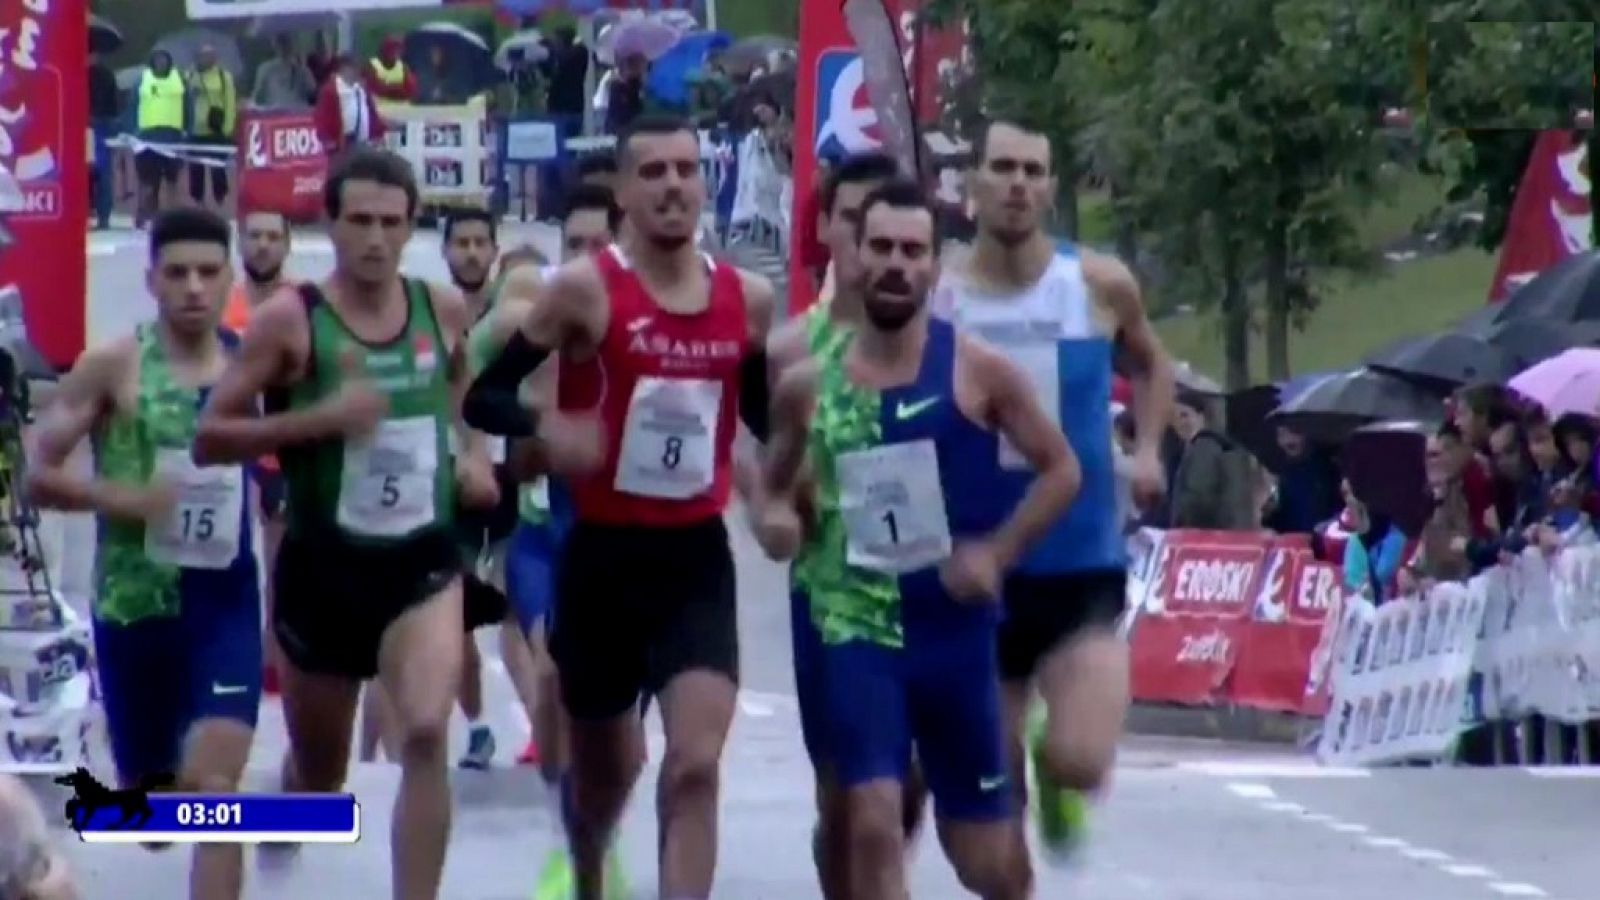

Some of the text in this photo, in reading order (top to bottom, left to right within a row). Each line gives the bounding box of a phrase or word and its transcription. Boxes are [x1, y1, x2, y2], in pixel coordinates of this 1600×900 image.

[662, 436, 683, 469] 8
[380, 475, 399, 507] 5
[182, 508, 215, 540] 15
[882, 510, 898, 544] 1
[1174, 560, 1253, 602] EROSKI
